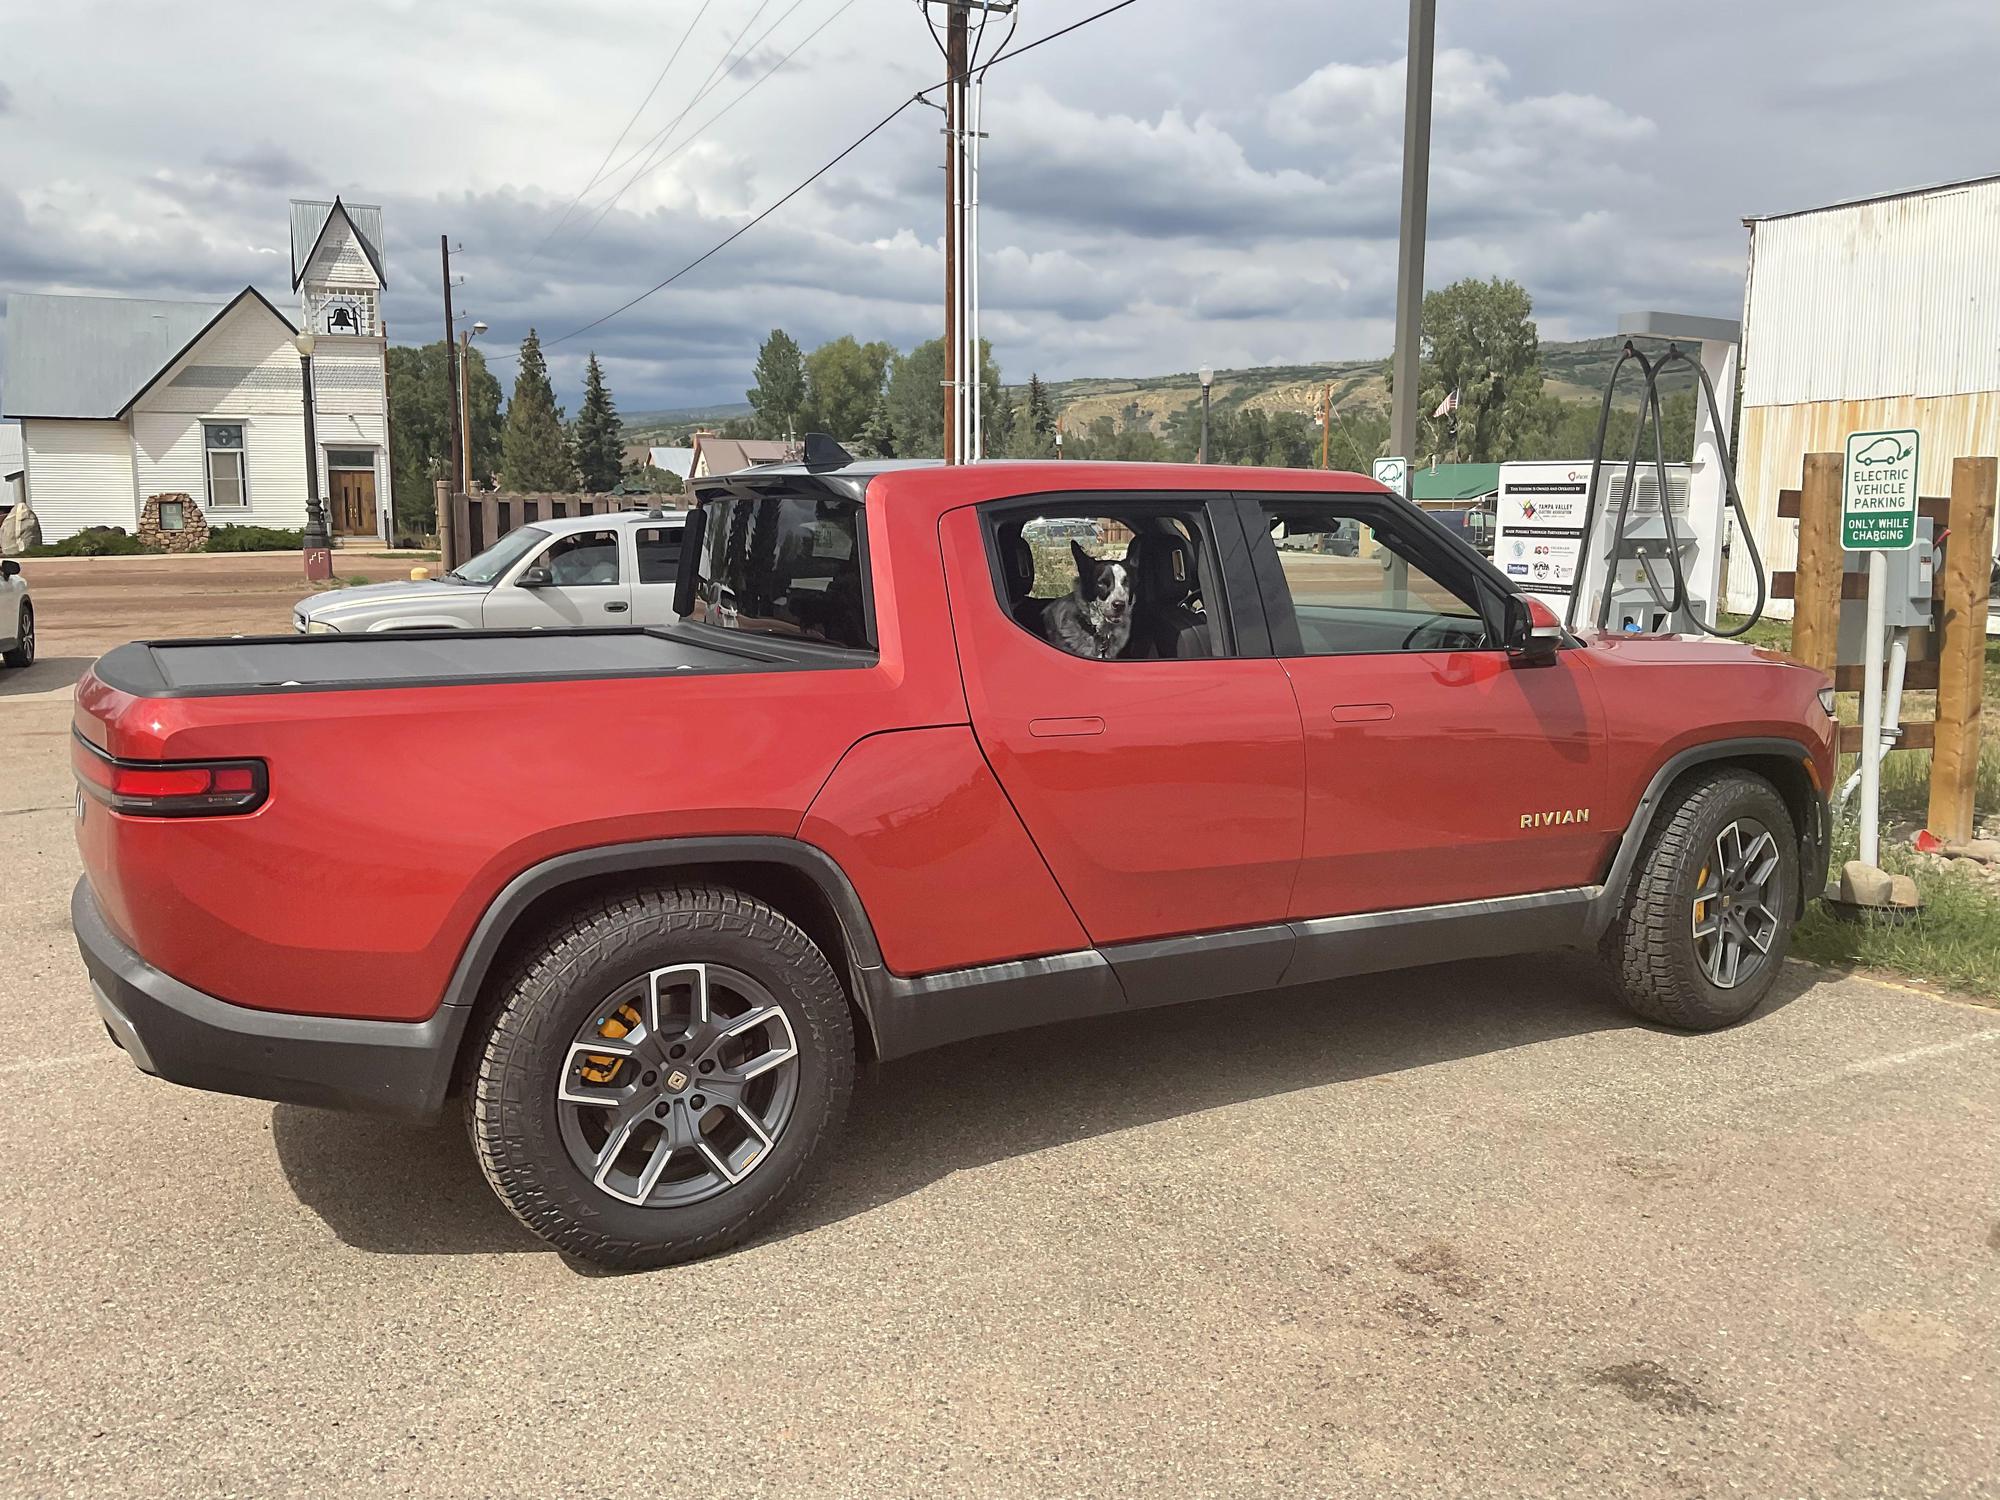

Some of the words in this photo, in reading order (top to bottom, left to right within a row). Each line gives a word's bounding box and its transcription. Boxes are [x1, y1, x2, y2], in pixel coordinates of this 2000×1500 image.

[1854, 469, 1909, 482] ELECTRIC
[1856, 483, 1906, 495] VEHICLE
[1854, 496, 1906, 509] PARKING
[1848, 519, 1876, 529] ONLY
[1878, 518, 1909, 529] WHILE
[1852, 529, 1904, 541] CHARGING
[1520, 808, 1590, 829] RIVIAN
